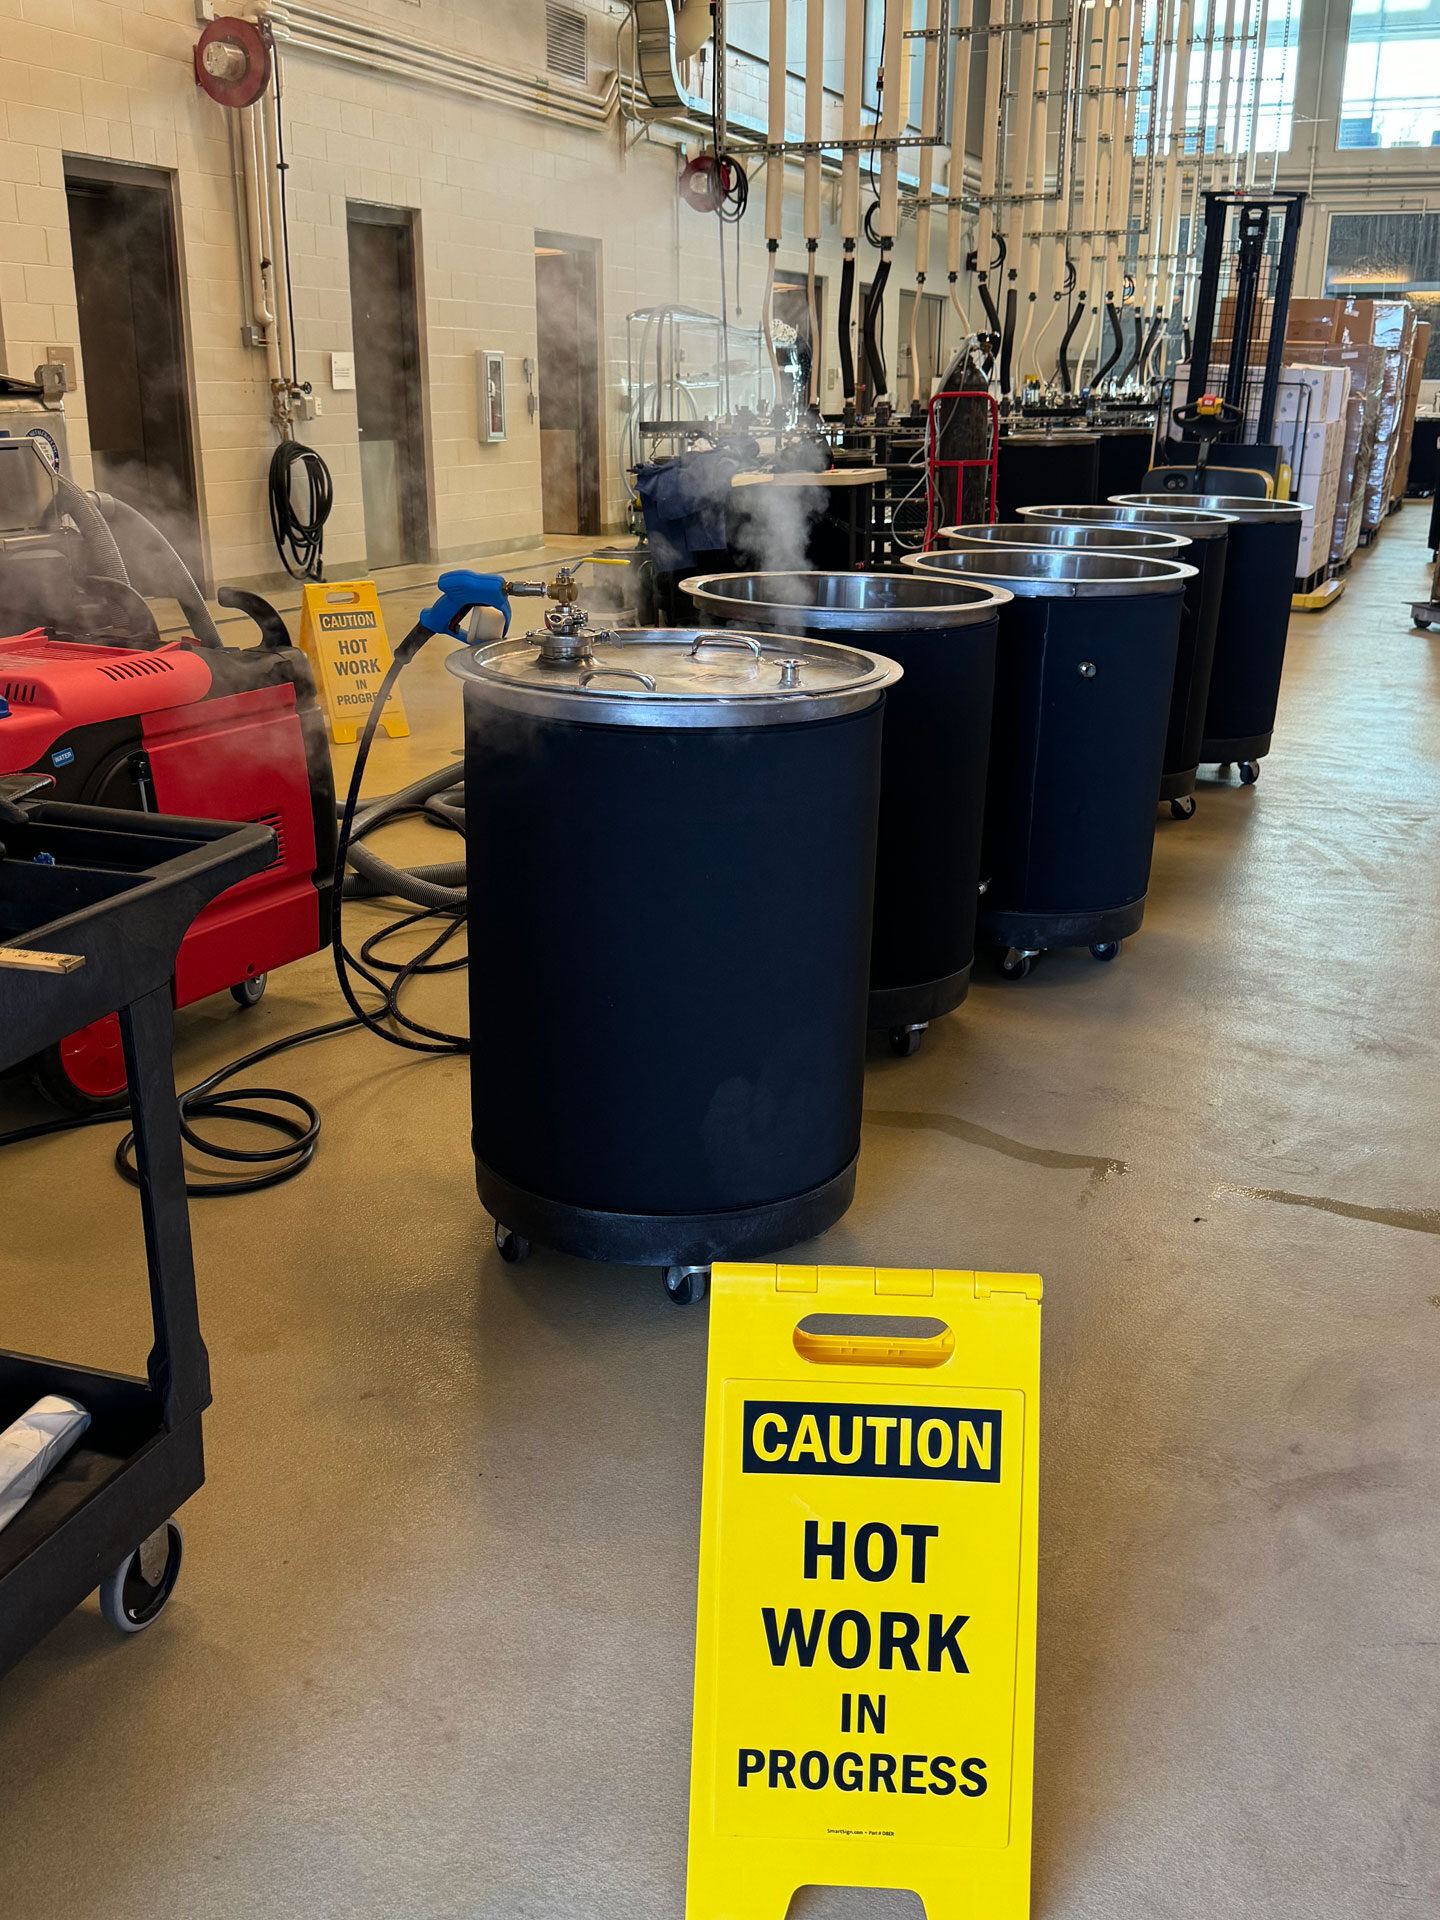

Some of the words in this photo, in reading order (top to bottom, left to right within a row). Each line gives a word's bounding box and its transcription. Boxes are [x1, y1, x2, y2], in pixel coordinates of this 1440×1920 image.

[322, 614, 374, 628] CAUTION
[338, 639, 367, 655] HOT
[333, 658, 381, 676] WORK
[355, 679, 367, 690] IN
[54, 751, 71, 763] WATER
[752, 1412, 993, 1471] CAUTION
[803, 1520, 939, 1584] HOT
[761, 1607, 970, 1674] WORK
[841, 1693, 886, 1735] IN
[737, 1748, 988, 1798] PROGRESS
